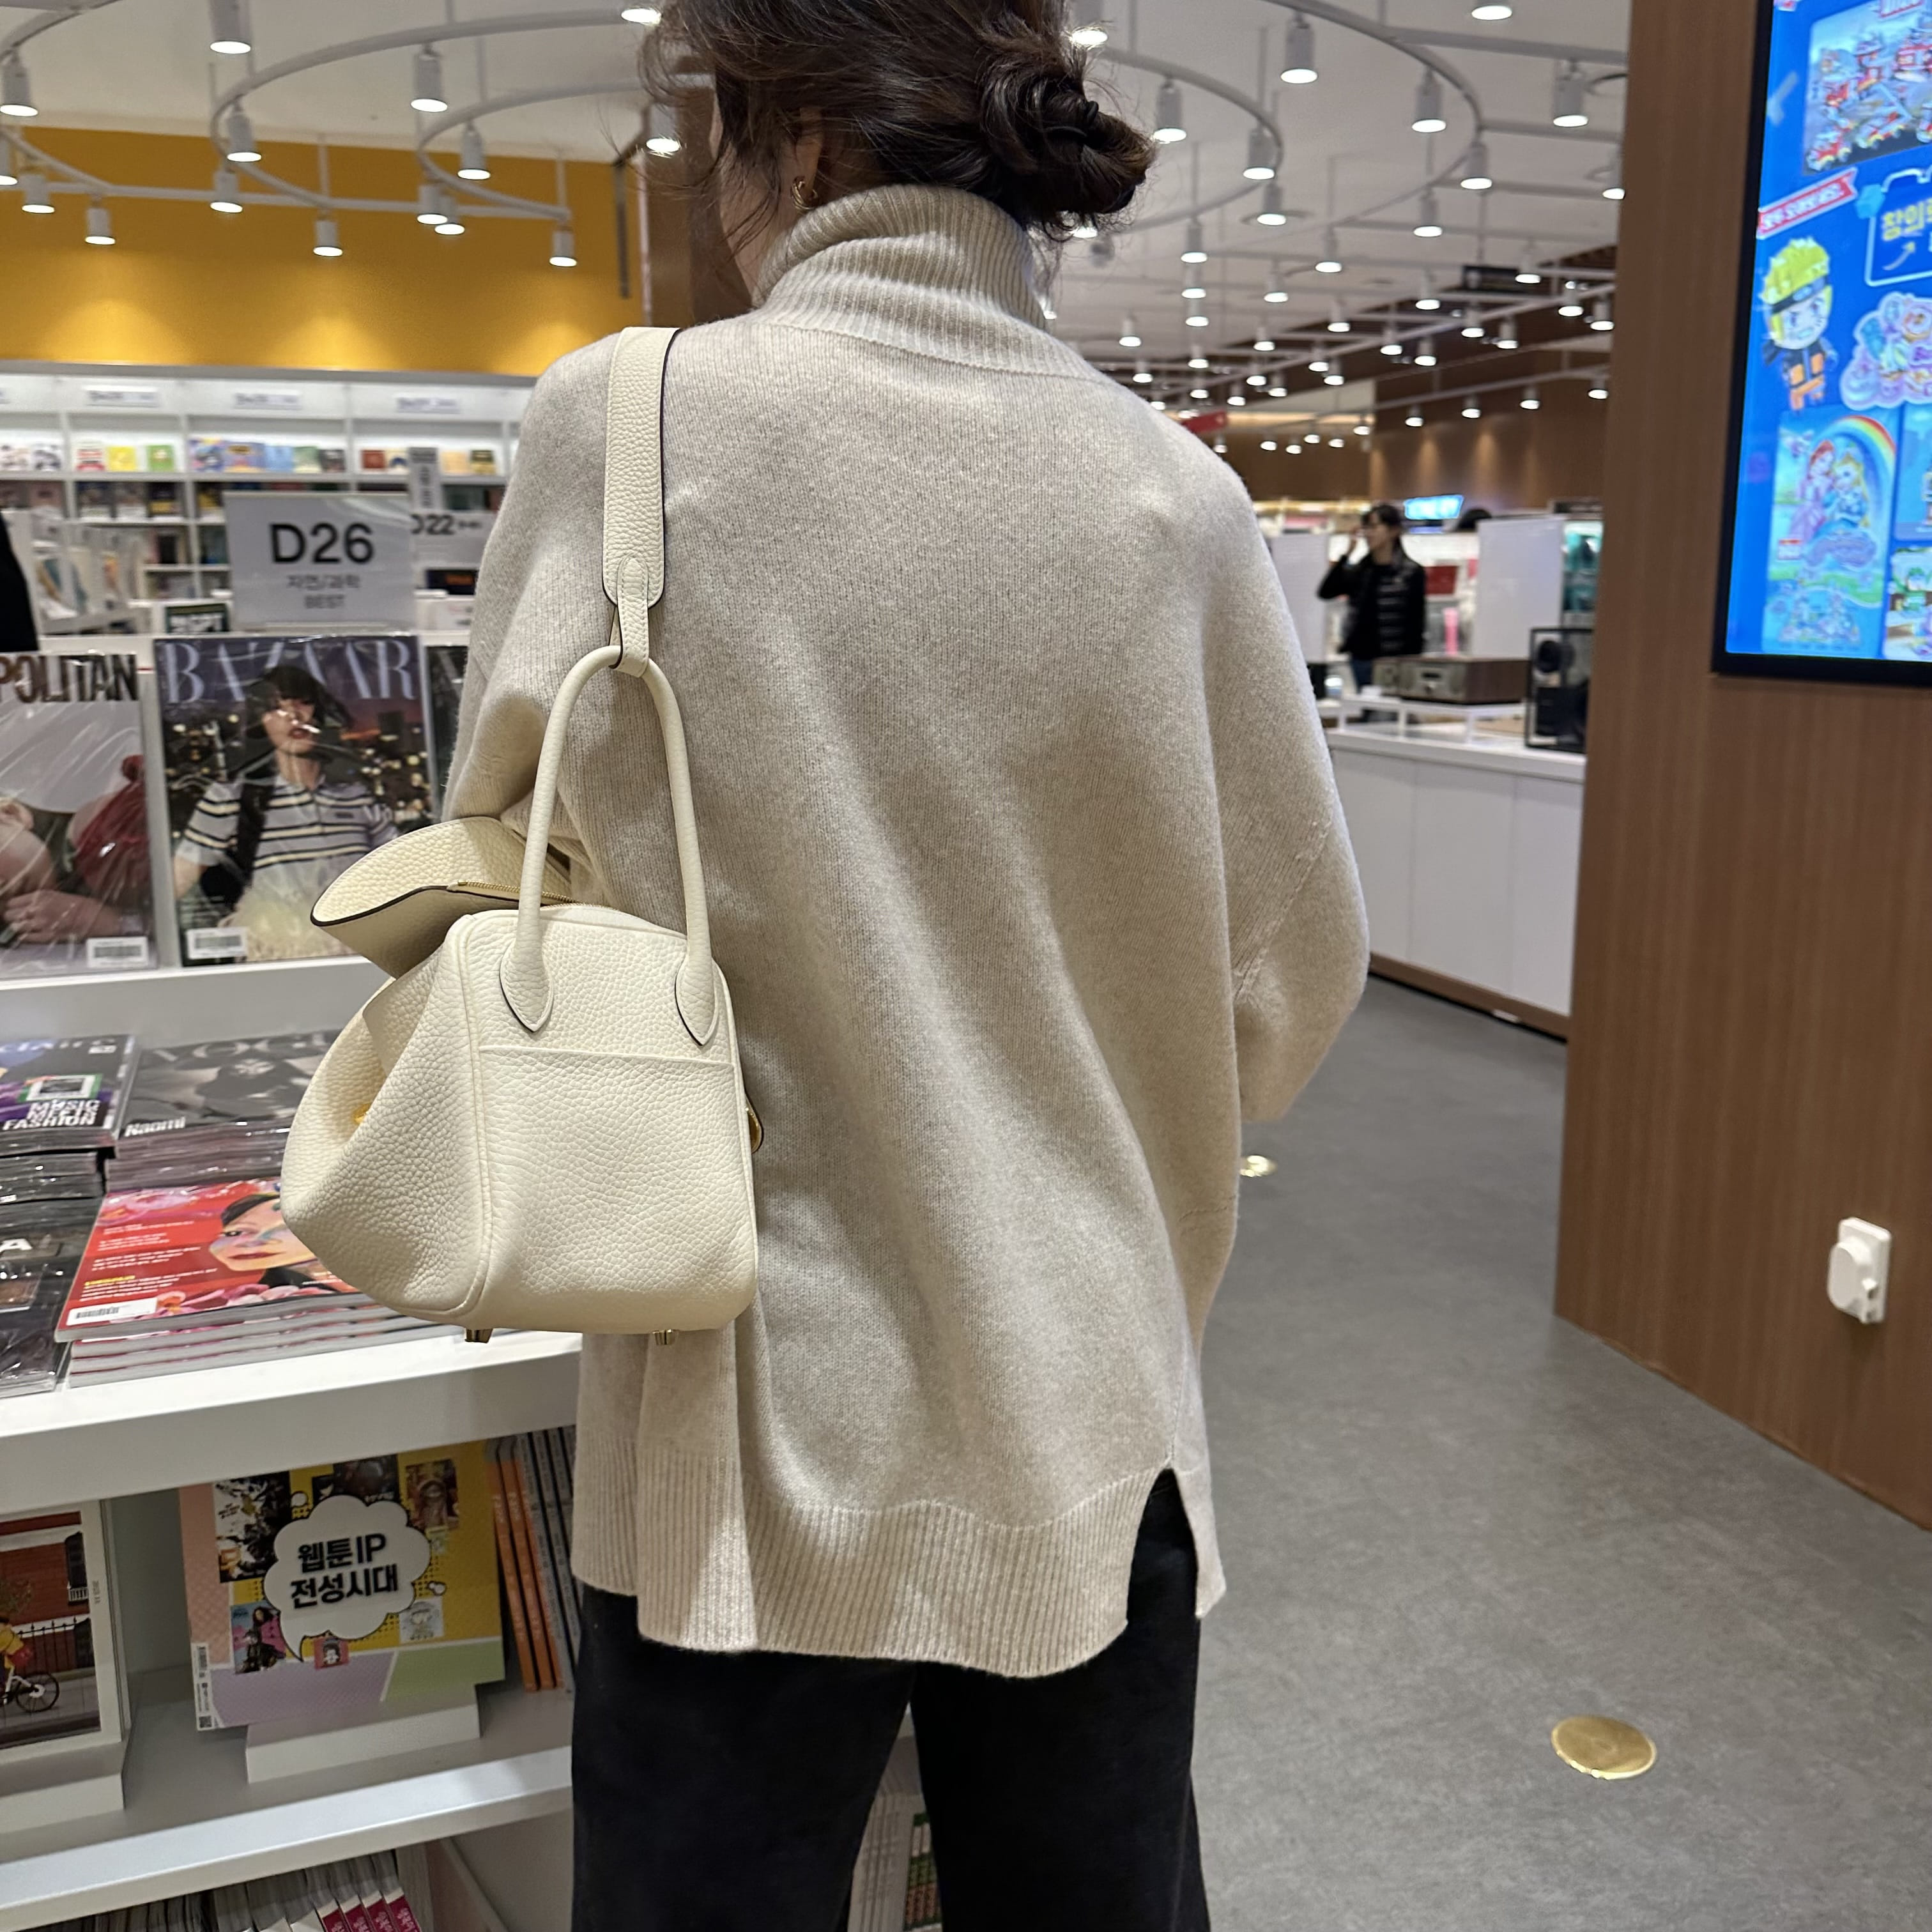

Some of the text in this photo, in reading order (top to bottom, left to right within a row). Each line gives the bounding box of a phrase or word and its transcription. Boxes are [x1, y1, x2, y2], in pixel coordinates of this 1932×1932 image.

[269, 523, 375, 564] D26
[303, 594, 345, 609] BEST
[29, 1099, 101, 1114] MUSIC
[3, 1116, 96, 1131] FASHION
[125, 1117, 186, 1137] Naomi
[291, 1563, 399, 1609] 전성시대
